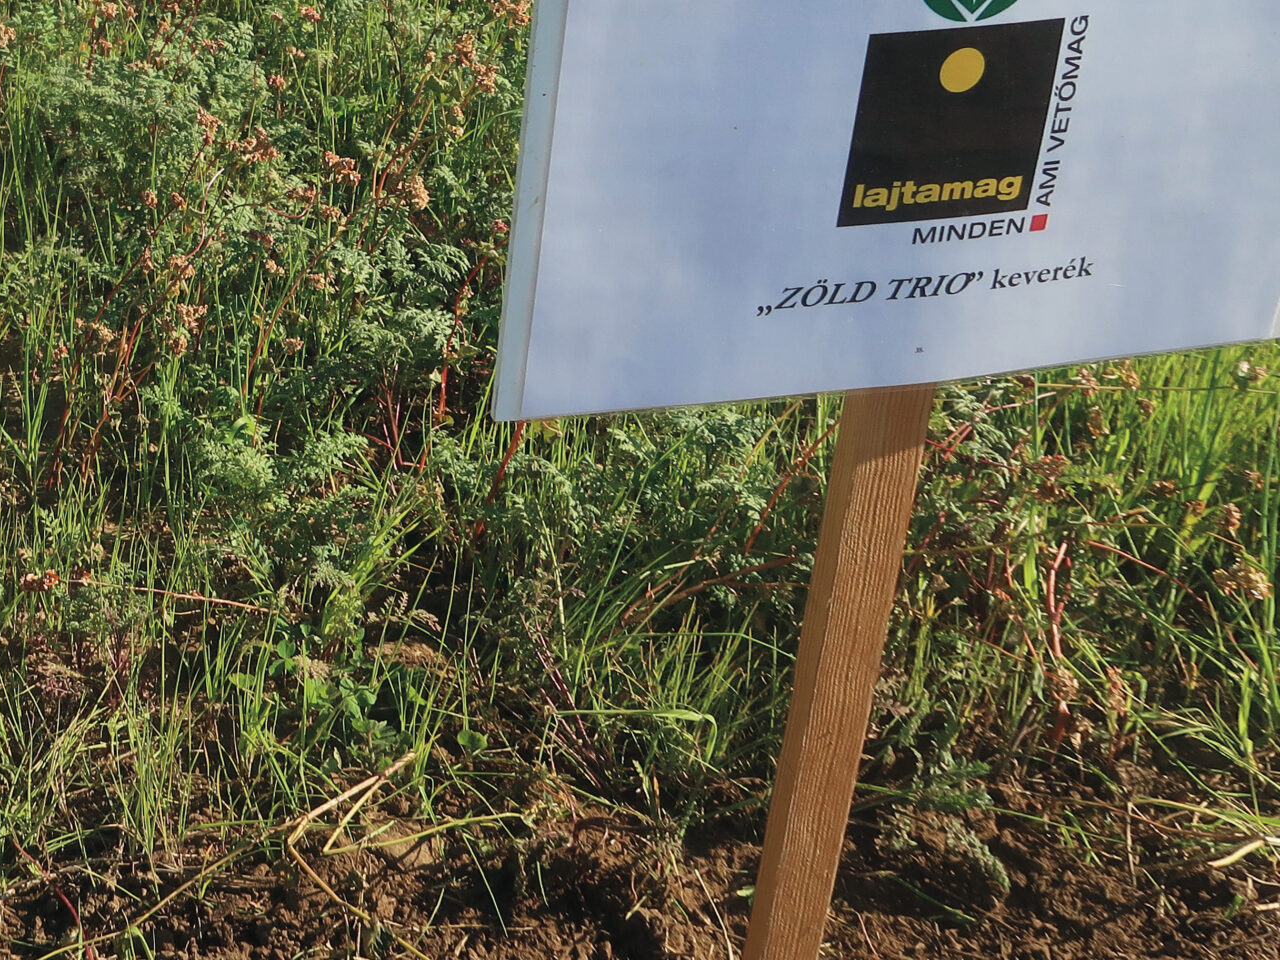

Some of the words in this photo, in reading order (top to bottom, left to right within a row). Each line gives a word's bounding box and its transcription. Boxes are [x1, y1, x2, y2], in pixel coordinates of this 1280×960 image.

[1047, 14, 1090, 153] VETŐMAG
[852, 175, 1023, 212] lajtamag
[1035, 159, 1061, 207] AMI
[911, 217, 1026, 245] MINDEN
[990, 256, 1095, 290] keverék
